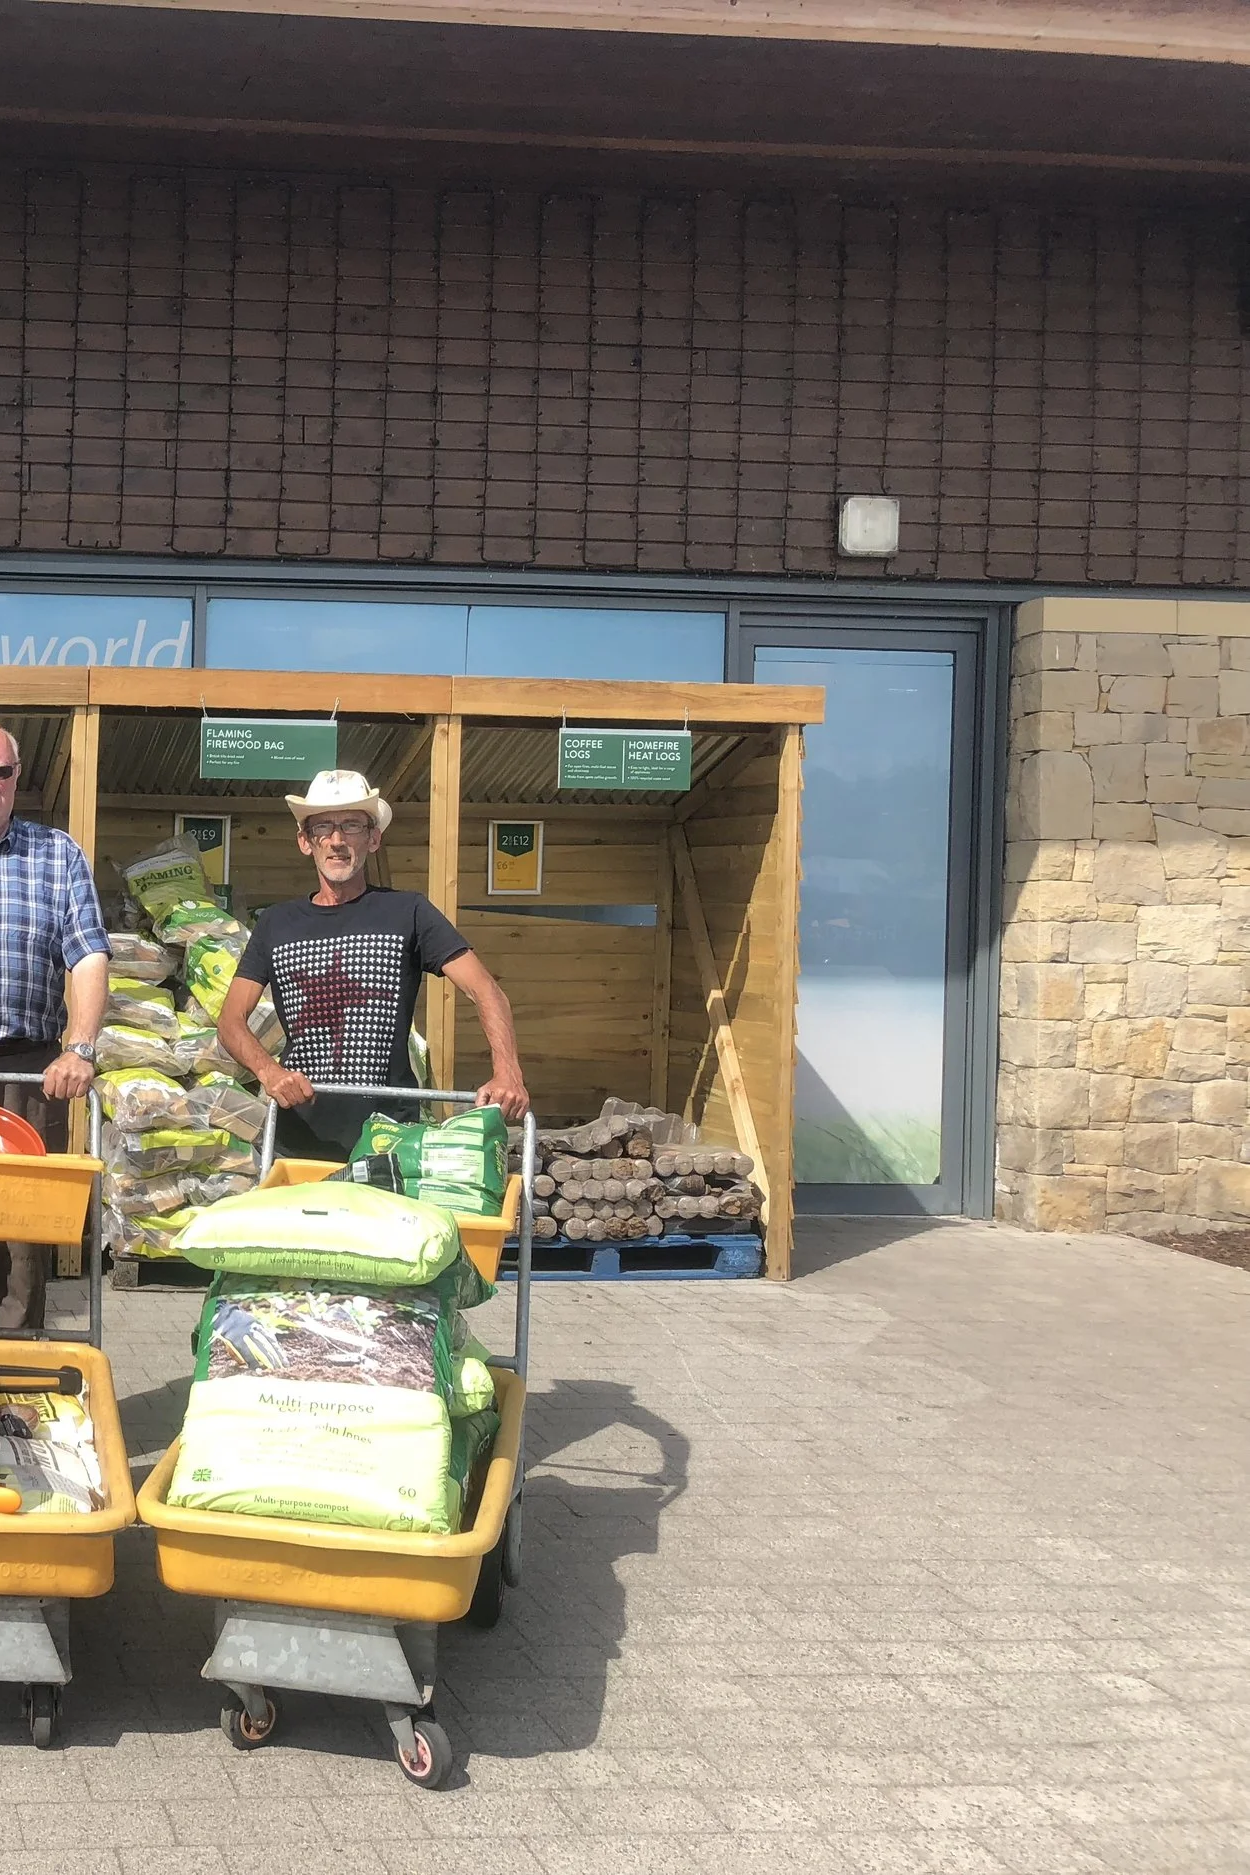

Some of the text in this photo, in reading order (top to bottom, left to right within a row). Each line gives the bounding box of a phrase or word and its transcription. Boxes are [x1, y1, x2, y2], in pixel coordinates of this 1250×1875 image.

[2, 619, 191, 668] world
[206, 728, 253, 739] FLAMING
[206, 739, 285, 750] FIREWOOD BAG
[564, 739, 603, 749] COFFEE
[628, 740, 679, 751] HOMEFIRE
[564, 750, 591, 759] LOGS
[628, 751, 681, 761] HEAT LOGS
[133, 864, 193, 887] FLAMING
[258, 1393, 375, 1415] Multi-purpose
[398, 1485, 417, 1499] 60
[253, 1494, 350, 1513] Multi-purpose compost
